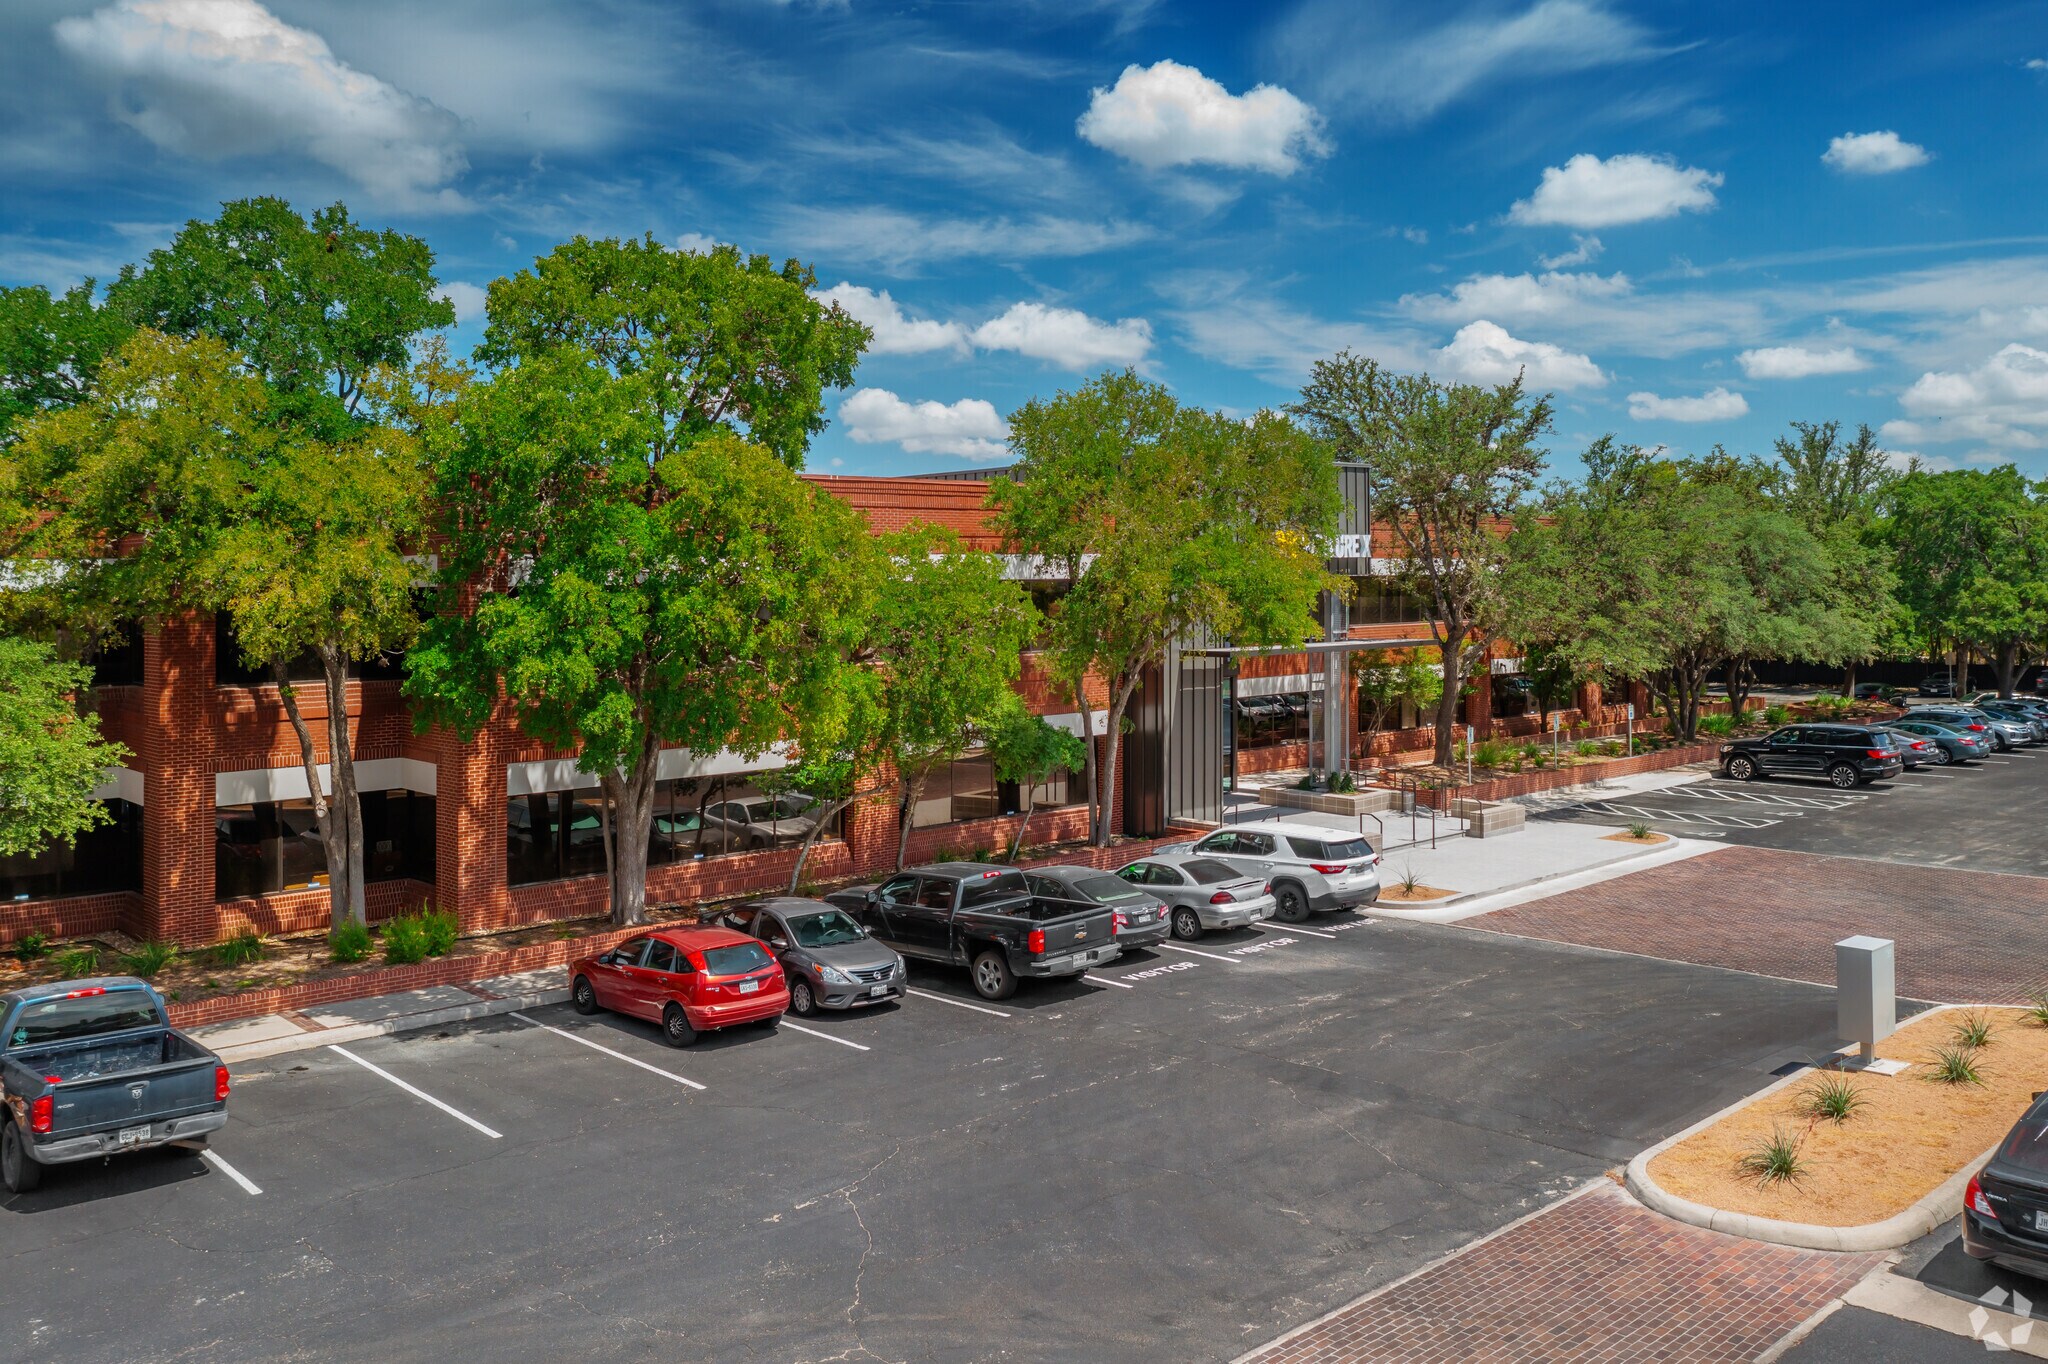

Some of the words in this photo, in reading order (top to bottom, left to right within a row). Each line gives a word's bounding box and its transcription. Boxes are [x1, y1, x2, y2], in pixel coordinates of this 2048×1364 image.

[1319, 918, 1383, 932] VISITOR
[1227, 937, 1300, 955] VISITOR
[1120, 961, 1200, 981] VISITOR
[1985, 1192, 2008, 1203] VERSA
